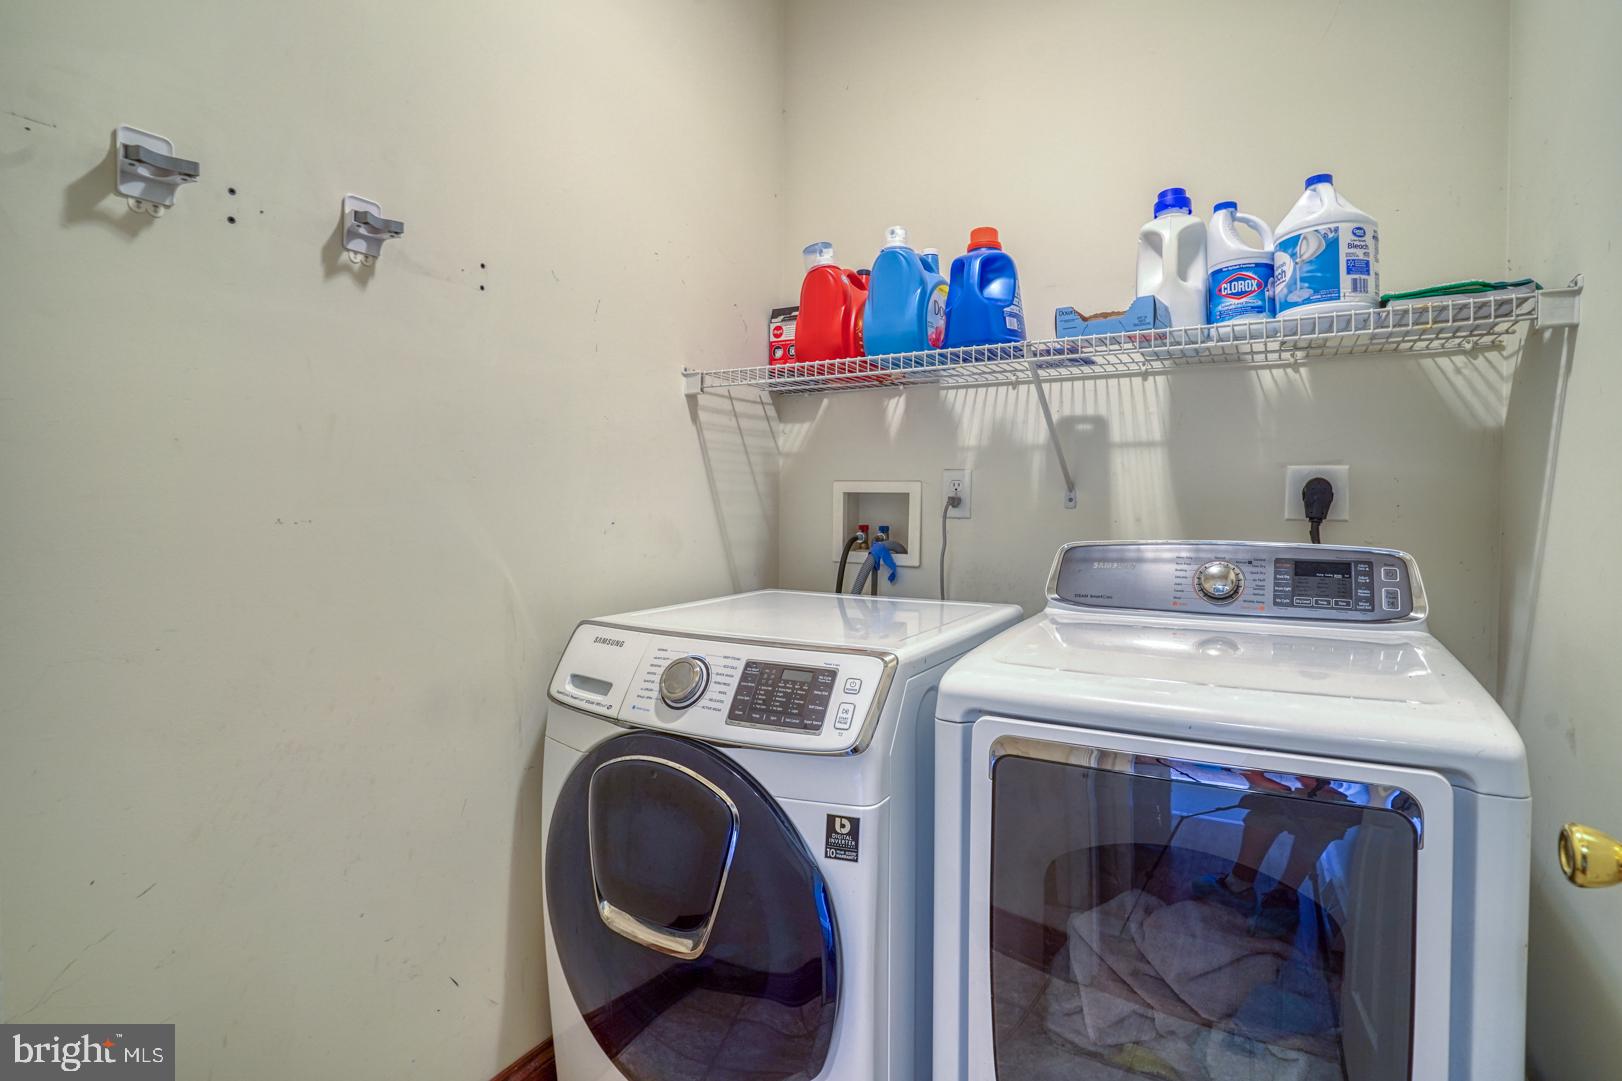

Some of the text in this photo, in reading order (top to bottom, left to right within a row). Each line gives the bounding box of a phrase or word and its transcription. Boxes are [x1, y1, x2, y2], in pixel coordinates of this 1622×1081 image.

[1347, 242, 1369, 250] Bleach
[1221, 279, 1258, 295] CLOROX
[593, 636, 625, 648] SAMSUNG
[829, 838, 856, 846] INVERTER
[826, 848, 836, 857] 10
